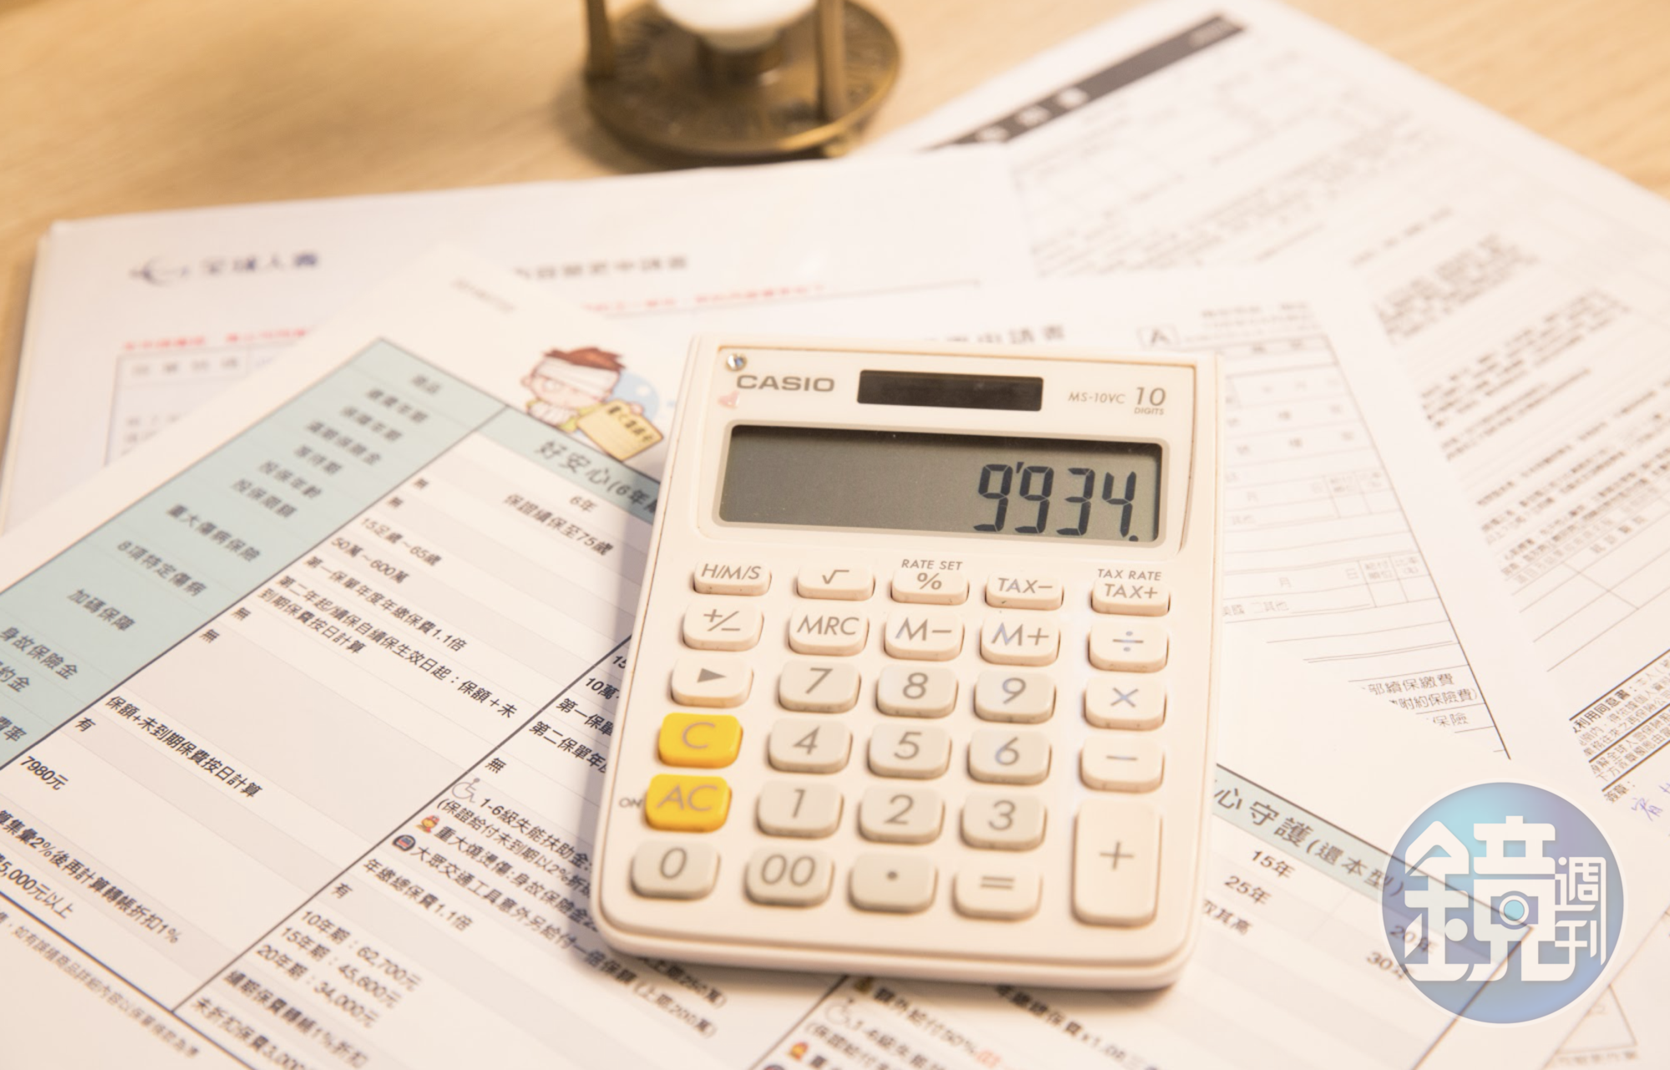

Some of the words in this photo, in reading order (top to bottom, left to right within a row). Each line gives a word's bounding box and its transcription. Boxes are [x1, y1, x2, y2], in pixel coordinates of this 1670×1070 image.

[736, 374, 835, 393] CASIO
[1134, 386, 1166, 407] 10
[1067, 391, 1126, 405] MS-10VC
[1134, 406, 1165, 416] DIGITS
[568, 494, 599, 513] 6年
[701, 563, 762, 581] H/M/S
[901, 559, 935, 570] RATE
[938, 561, 963, 571] SET
[1097, 568, 1123, 579] TAX
[1127, 571, 1162, 582] RATE
[1104, 583, 1159, 600] TAX+
[66, 588, 136, 632] 加碼保障
[199, 628, 221, 644] 無
[796, 615, 861, 636] MRC
[991, 622, 1050, 647] M+
[0, 626, 79, 681] 身故保險金
[805, 667, 833, 695] 7
[902, 672, 929, 700] 8
[1001, 677, 1027, 705] 9
[75, 716, 97, 733] 有
[682, 721, 716, 749] C
[793, 726, 821, 755] 4
[893, 731, 923, 760] 5
[994, 736, 1020, 766] 6
[19, 755, 69, 791] 7980元
[485, 757, 507, 774] 無
[619, 797, 642, 809] ON
[656, 784, 718, 812] AC
[792, 788, 807, 819] 1
[884, 794, 914, 825] 2
[987, 800, 1017, 831] 3
[660, 847, 687, 880] 0
[761, 854, 816, 887] 00
[1250, 849, 1296, 879] 15年
[331, 881, 353, 899] 有
[1223, 874, 1272, 906] 25年
